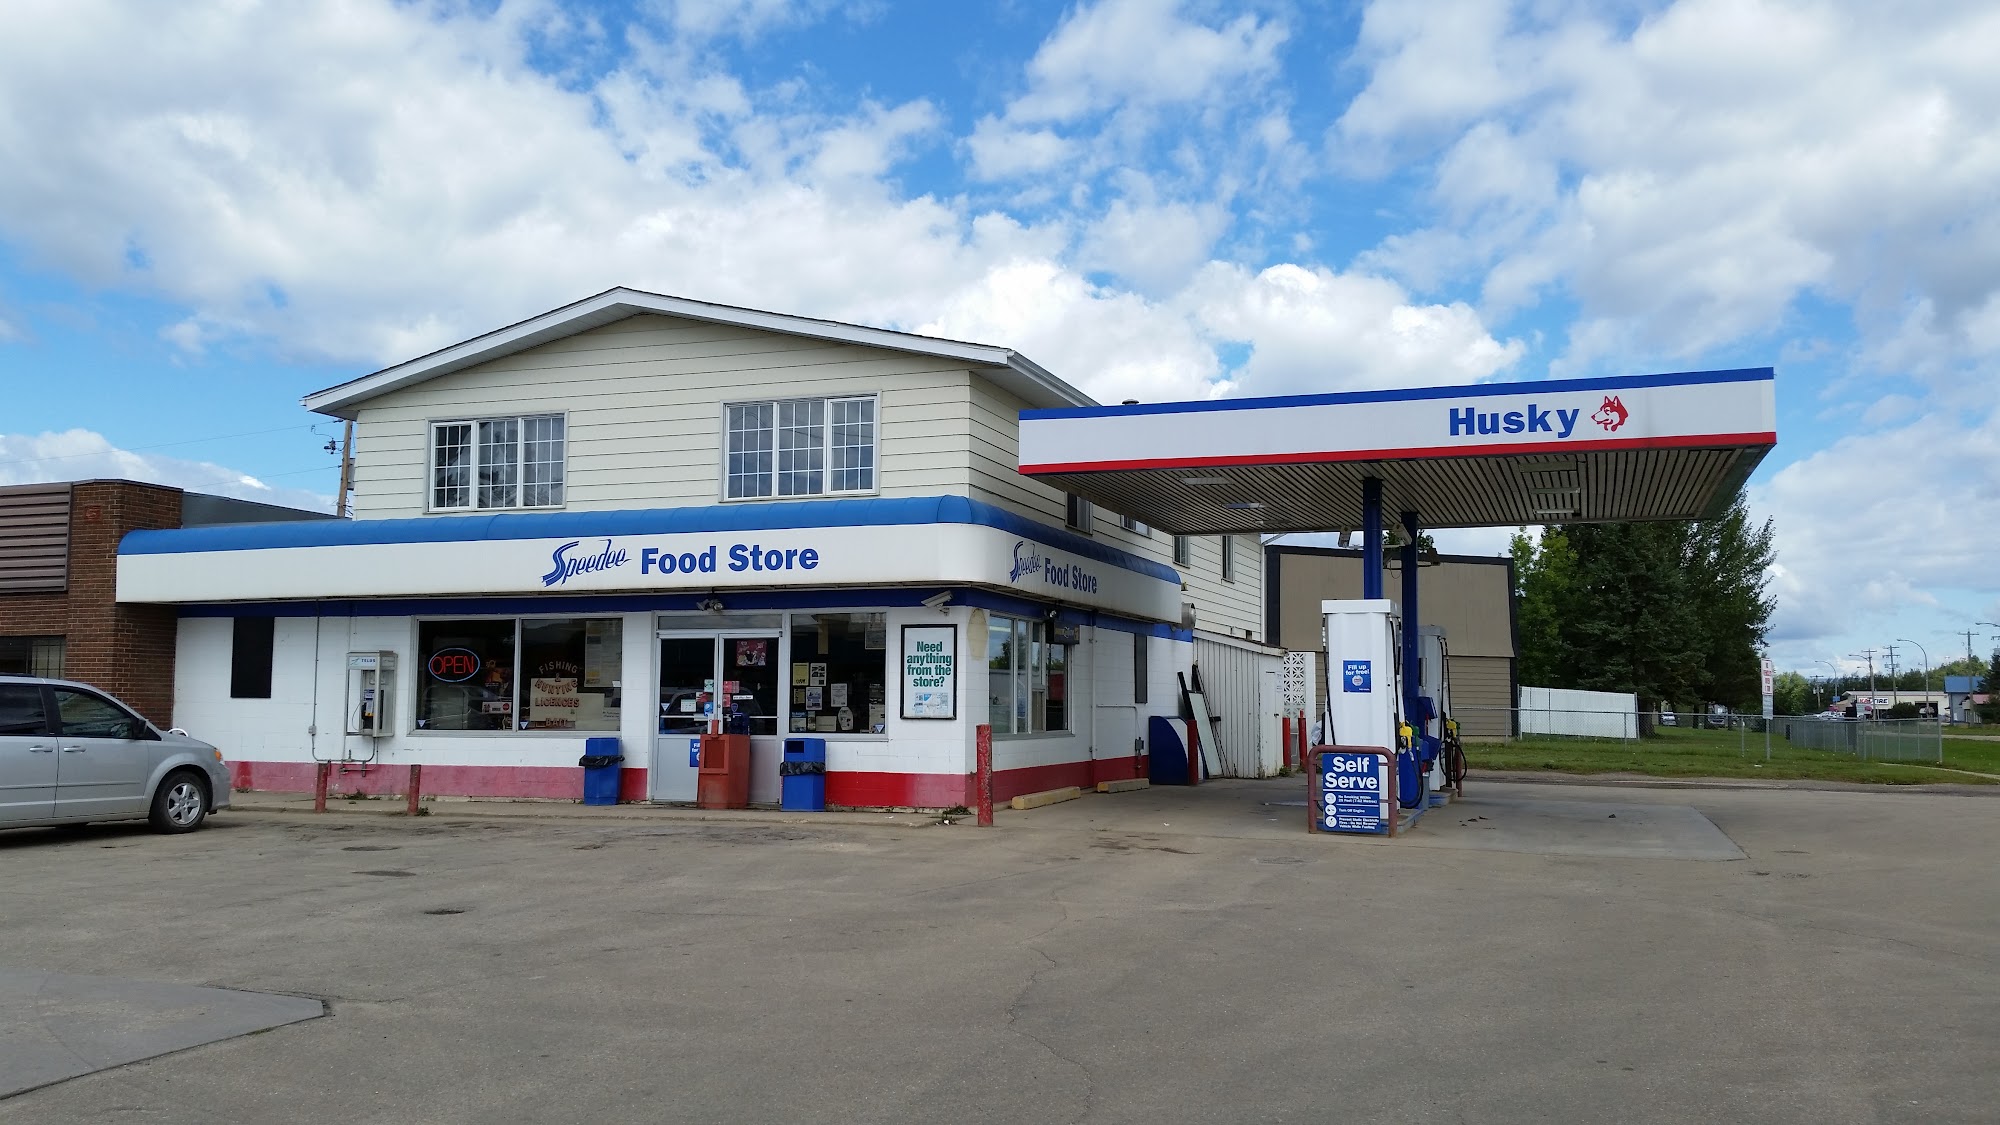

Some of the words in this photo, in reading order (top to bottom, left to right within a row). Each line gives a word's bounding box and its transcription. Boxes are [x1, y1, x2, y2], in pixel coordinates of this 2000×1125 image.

[1449, 404, 1580, 438] Husky
[541, 538, 632, 587] Speedee
[641, 545, 717, 575] Food
[728, 543, 819, 572] Store
[1009, 540, 1042, 584] Speedee
[1044, 557, 1069, 588] Food
[1072, 565, 1098, 594] Store
[916, 641, 943, 653] Need
[431, 655, 475, 674] OPEN
[906, 652, 952, 666] anything
[538, 661, 578, 674] FISHING
[907, 664, 932, 676] from
[934, 664, 952, 676] the
[555, 672, 561, 683] &
[912, 676, 945, 688] store?
[534, 678, 578, 695] HUNTING
[534, 697, 580, 708] LICENCES
[545, 717, 568, 728] BAIT
[1332, 756, 1370, 773] Self
[1325, 772, 1378, 789] Serve
